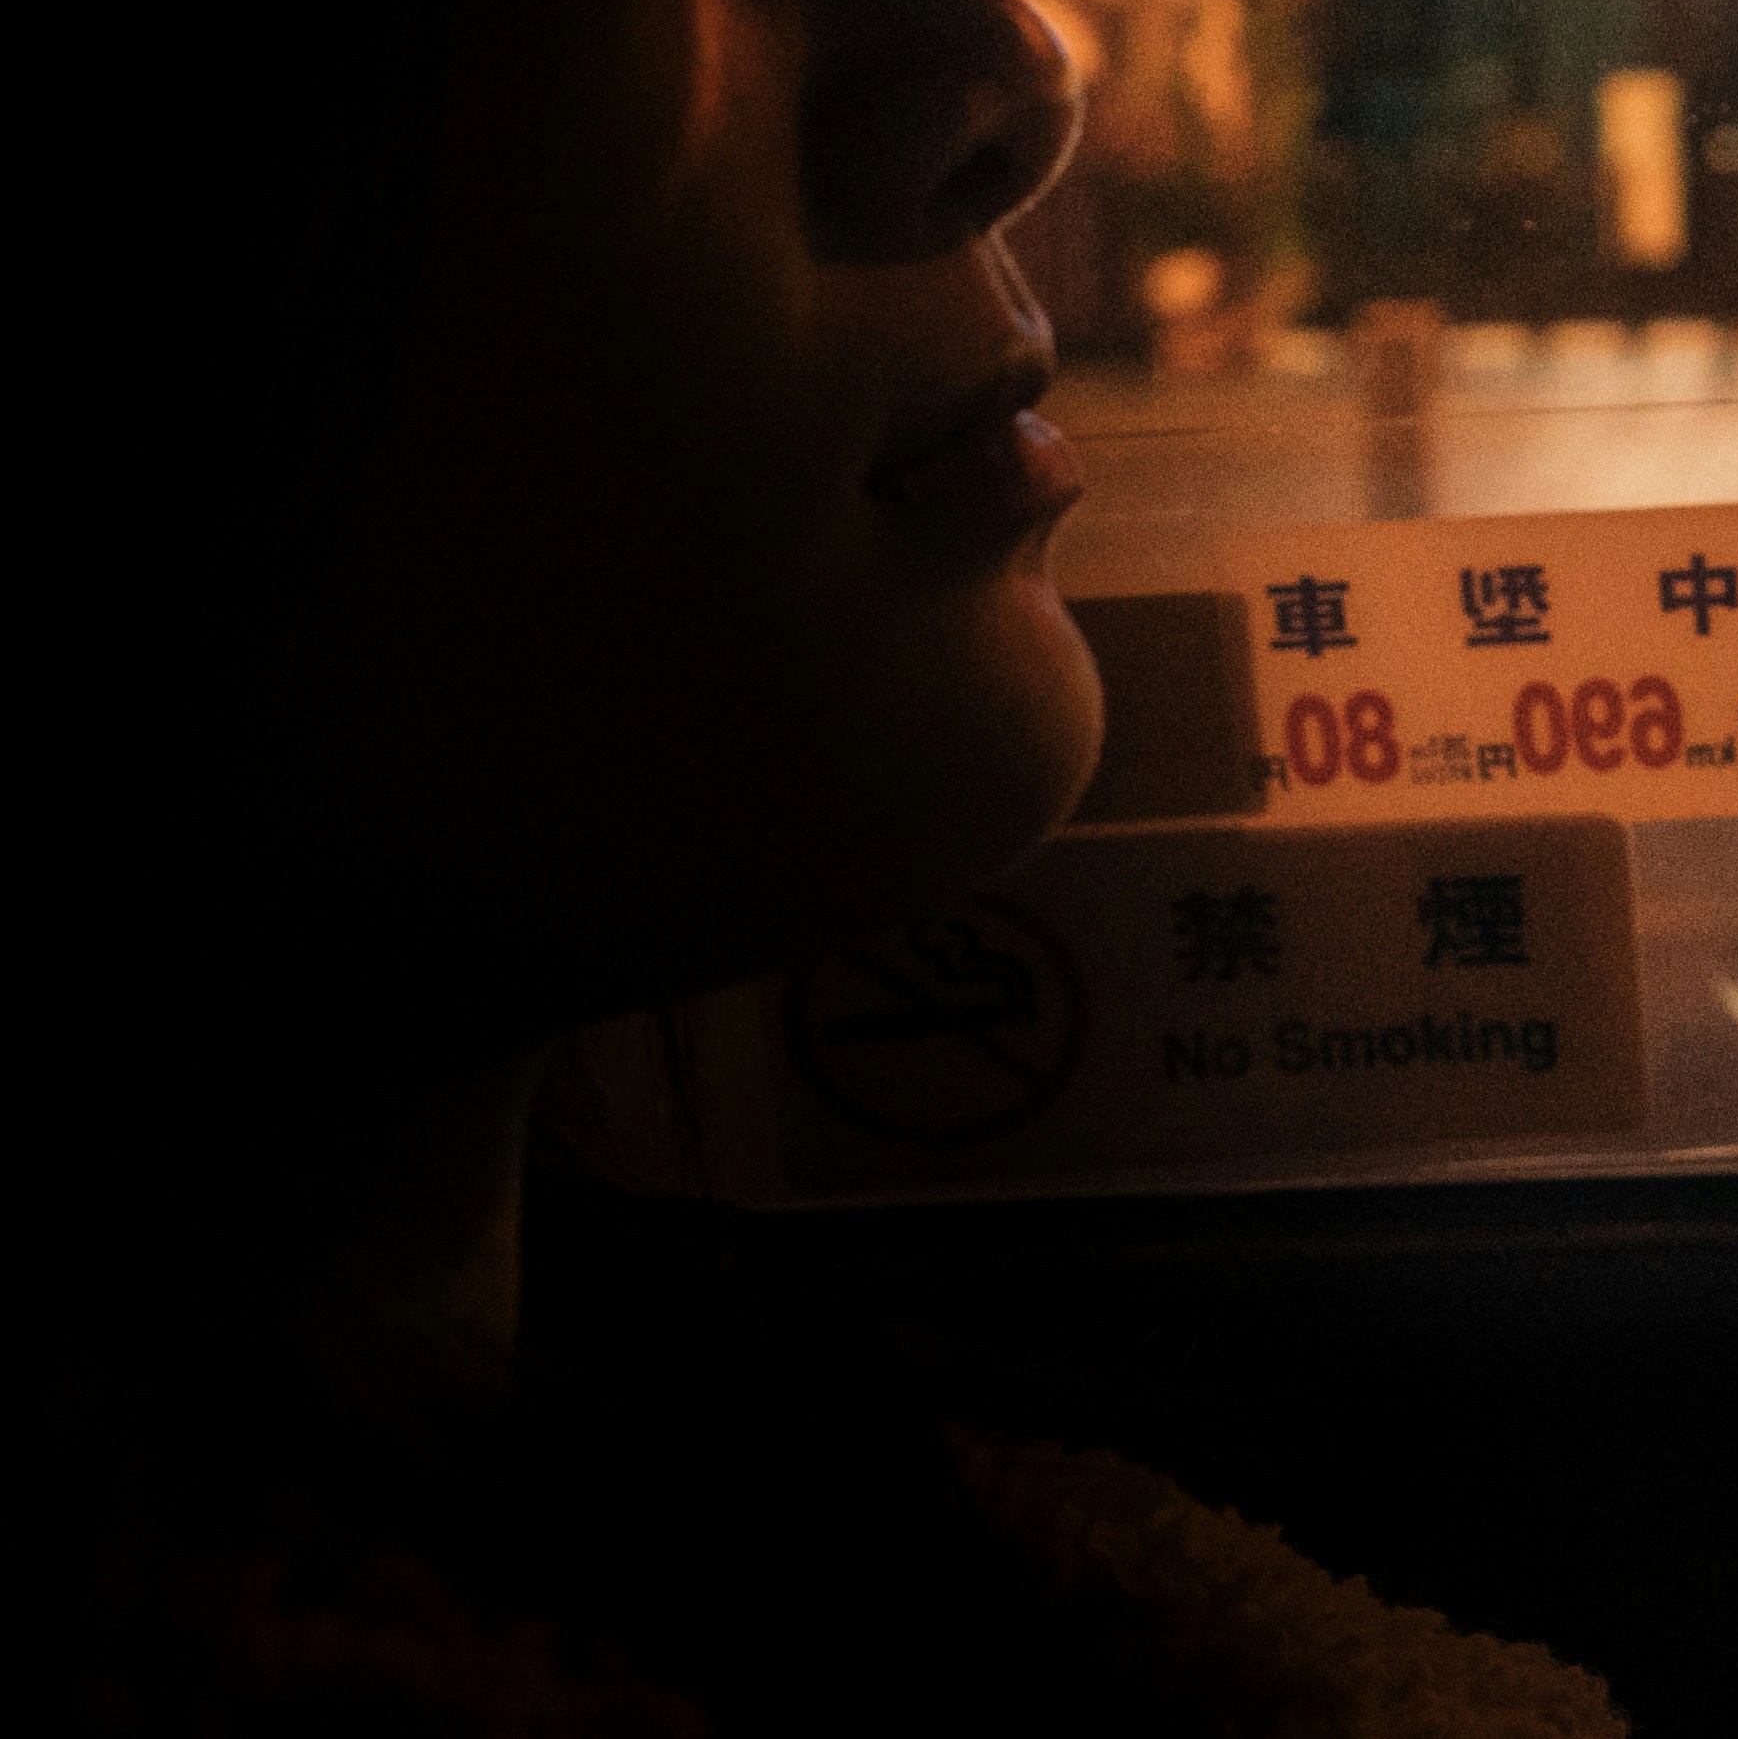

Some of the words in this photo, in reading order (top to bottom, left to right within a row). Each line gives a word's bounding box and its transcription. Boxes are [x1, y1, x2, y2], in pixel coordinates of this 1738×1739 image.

[1171, 874, 1530, 980] 禁煙
[1163, 1028, 1250, 1084] No
[1274, 1010, 1558, 1073] Smoking
